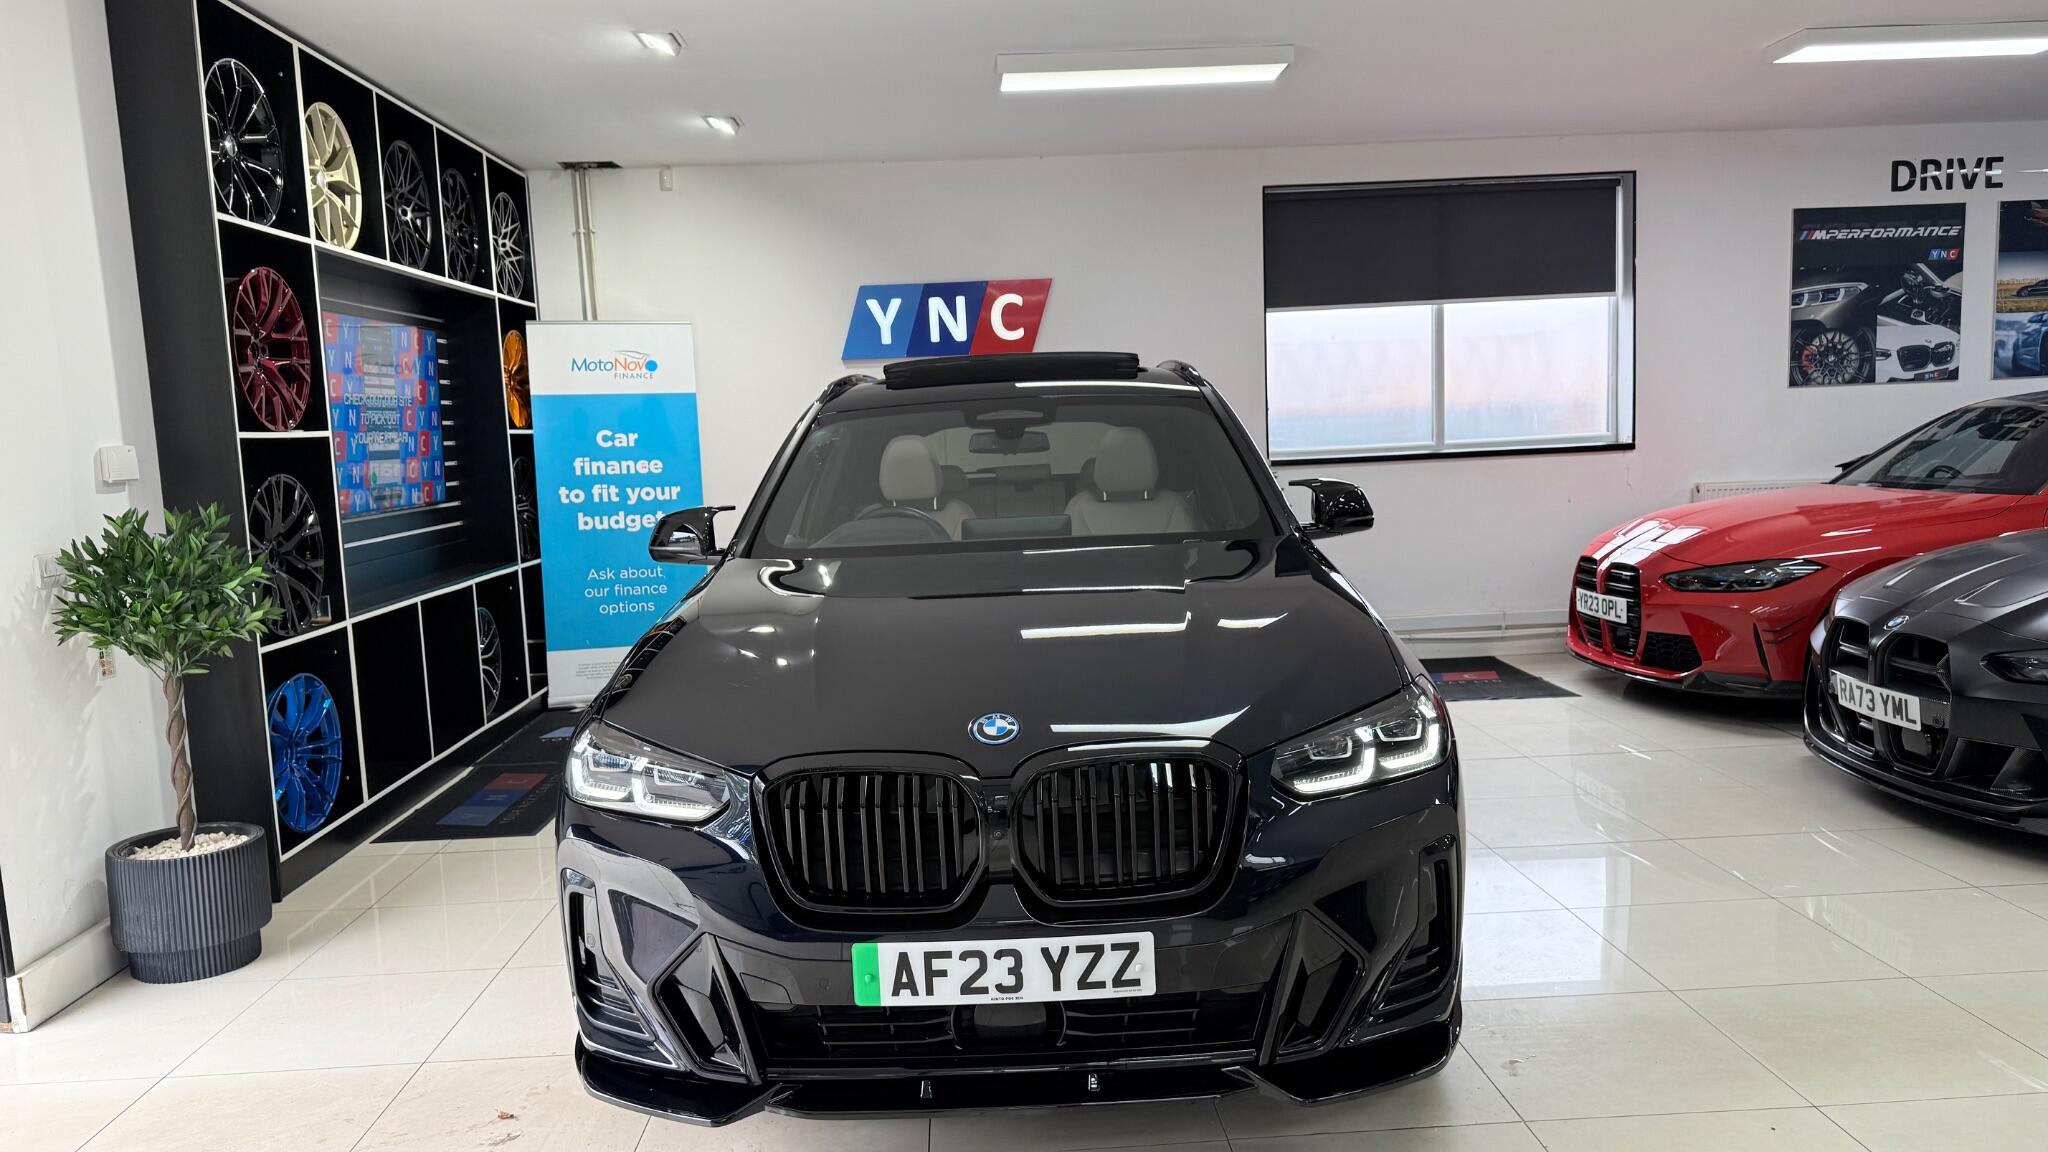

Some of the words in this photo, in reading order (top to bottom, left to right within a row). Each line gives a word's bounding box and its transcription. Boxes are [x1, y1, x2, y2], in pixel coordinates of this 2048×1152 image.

[1890, 156, 2004, 192] DRIVE
[866, 294, 1025, 345] YNC
[399, 396, 413, 407] SITE
[360, 413, 370, 424] TO
[387, 413, 400, 424] OUT
[596, 429, 638, 448] Car
[573, 457, 663, 476] finance
[558, 486, 585, 504] to
[592, 484, 620, 502] fit
[626, 485, 681, 505] your
[588, 568, 615, 580] Ask
[584, 587, 609, 597] our
[614, 584, 667, 596] finance
[599, 601, 655, 615] options
[1578, 591, 1599, 613] YR23
[1602, 598, 1621, 619] OPL
[1839, 678, 1875, 712] RA73
[1880, 692, 1917, 724] YML
[891, 948, 1024, 997] AF23
[1040, 942, 1142, 992] YZZ
